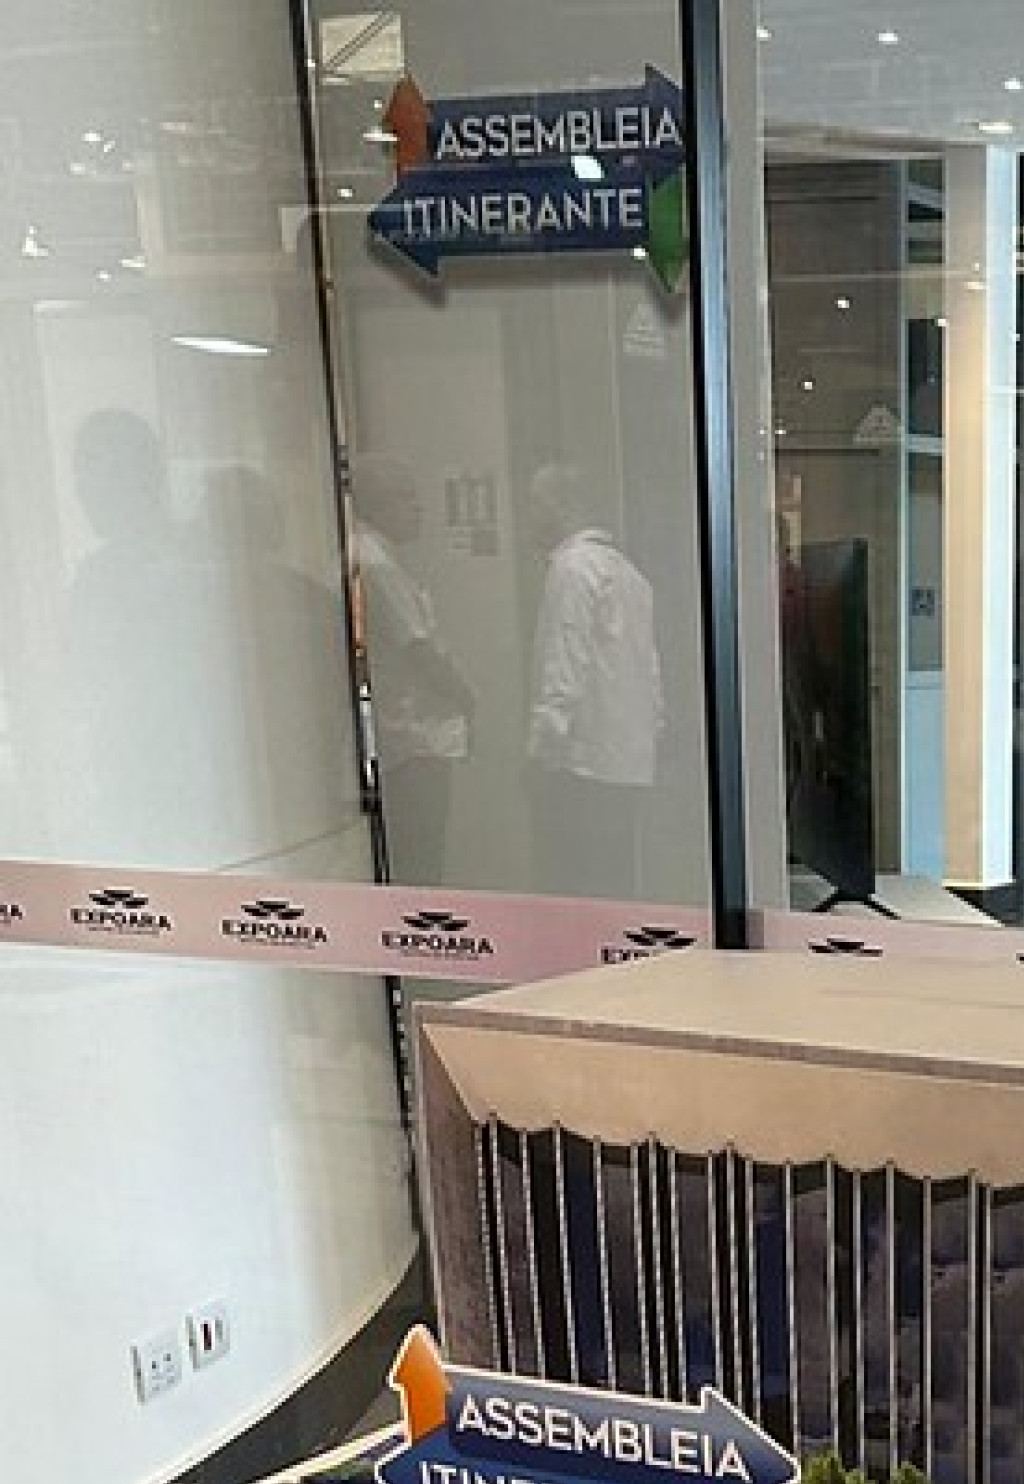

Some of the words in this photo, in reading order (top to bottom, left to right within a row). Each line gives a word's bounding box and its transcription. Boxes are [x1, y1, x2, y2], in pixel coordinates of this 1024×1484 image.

[436, 105, 684, 160] ASSEMBLEIA
[403, 187, 643, 238] ITINERANTE
[456, 1394, 753, 1484] ASSEMBLEIA
